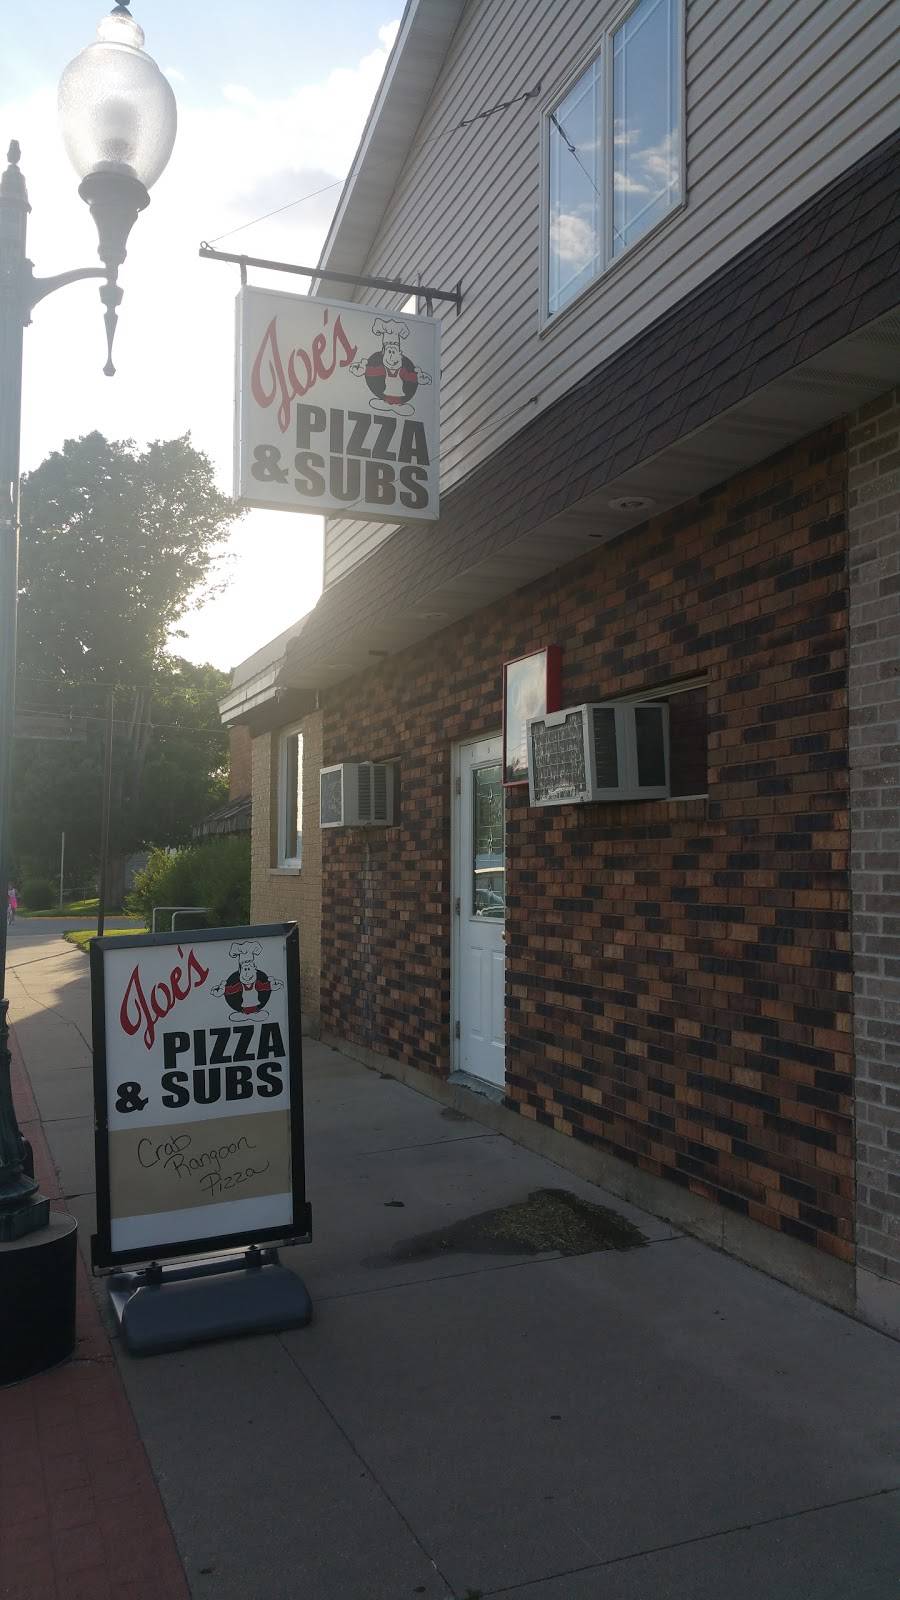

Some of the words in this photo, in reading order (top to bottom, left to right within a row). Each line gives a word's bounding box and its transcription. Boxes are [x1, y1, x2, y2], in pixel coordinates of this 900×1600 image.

[251, 308, 358, 433] Joe's
[296, 403, 430, 466] PIZZA
[251, 444, 288, 484] &
[294, 451, 429, 509] SUBS
[120, 944, 210, 1050] Joe's
[163, 1022, 286, 1069] PIZZA
[115, 1081, 149, 1113] &
[161, 1062, 283, 1109] SUBS
[137, 1134, 192, 1168] Crab
[163, 1136, 257, 1179] Rangoon
[200, 1160, 270, 1197] Pizza
